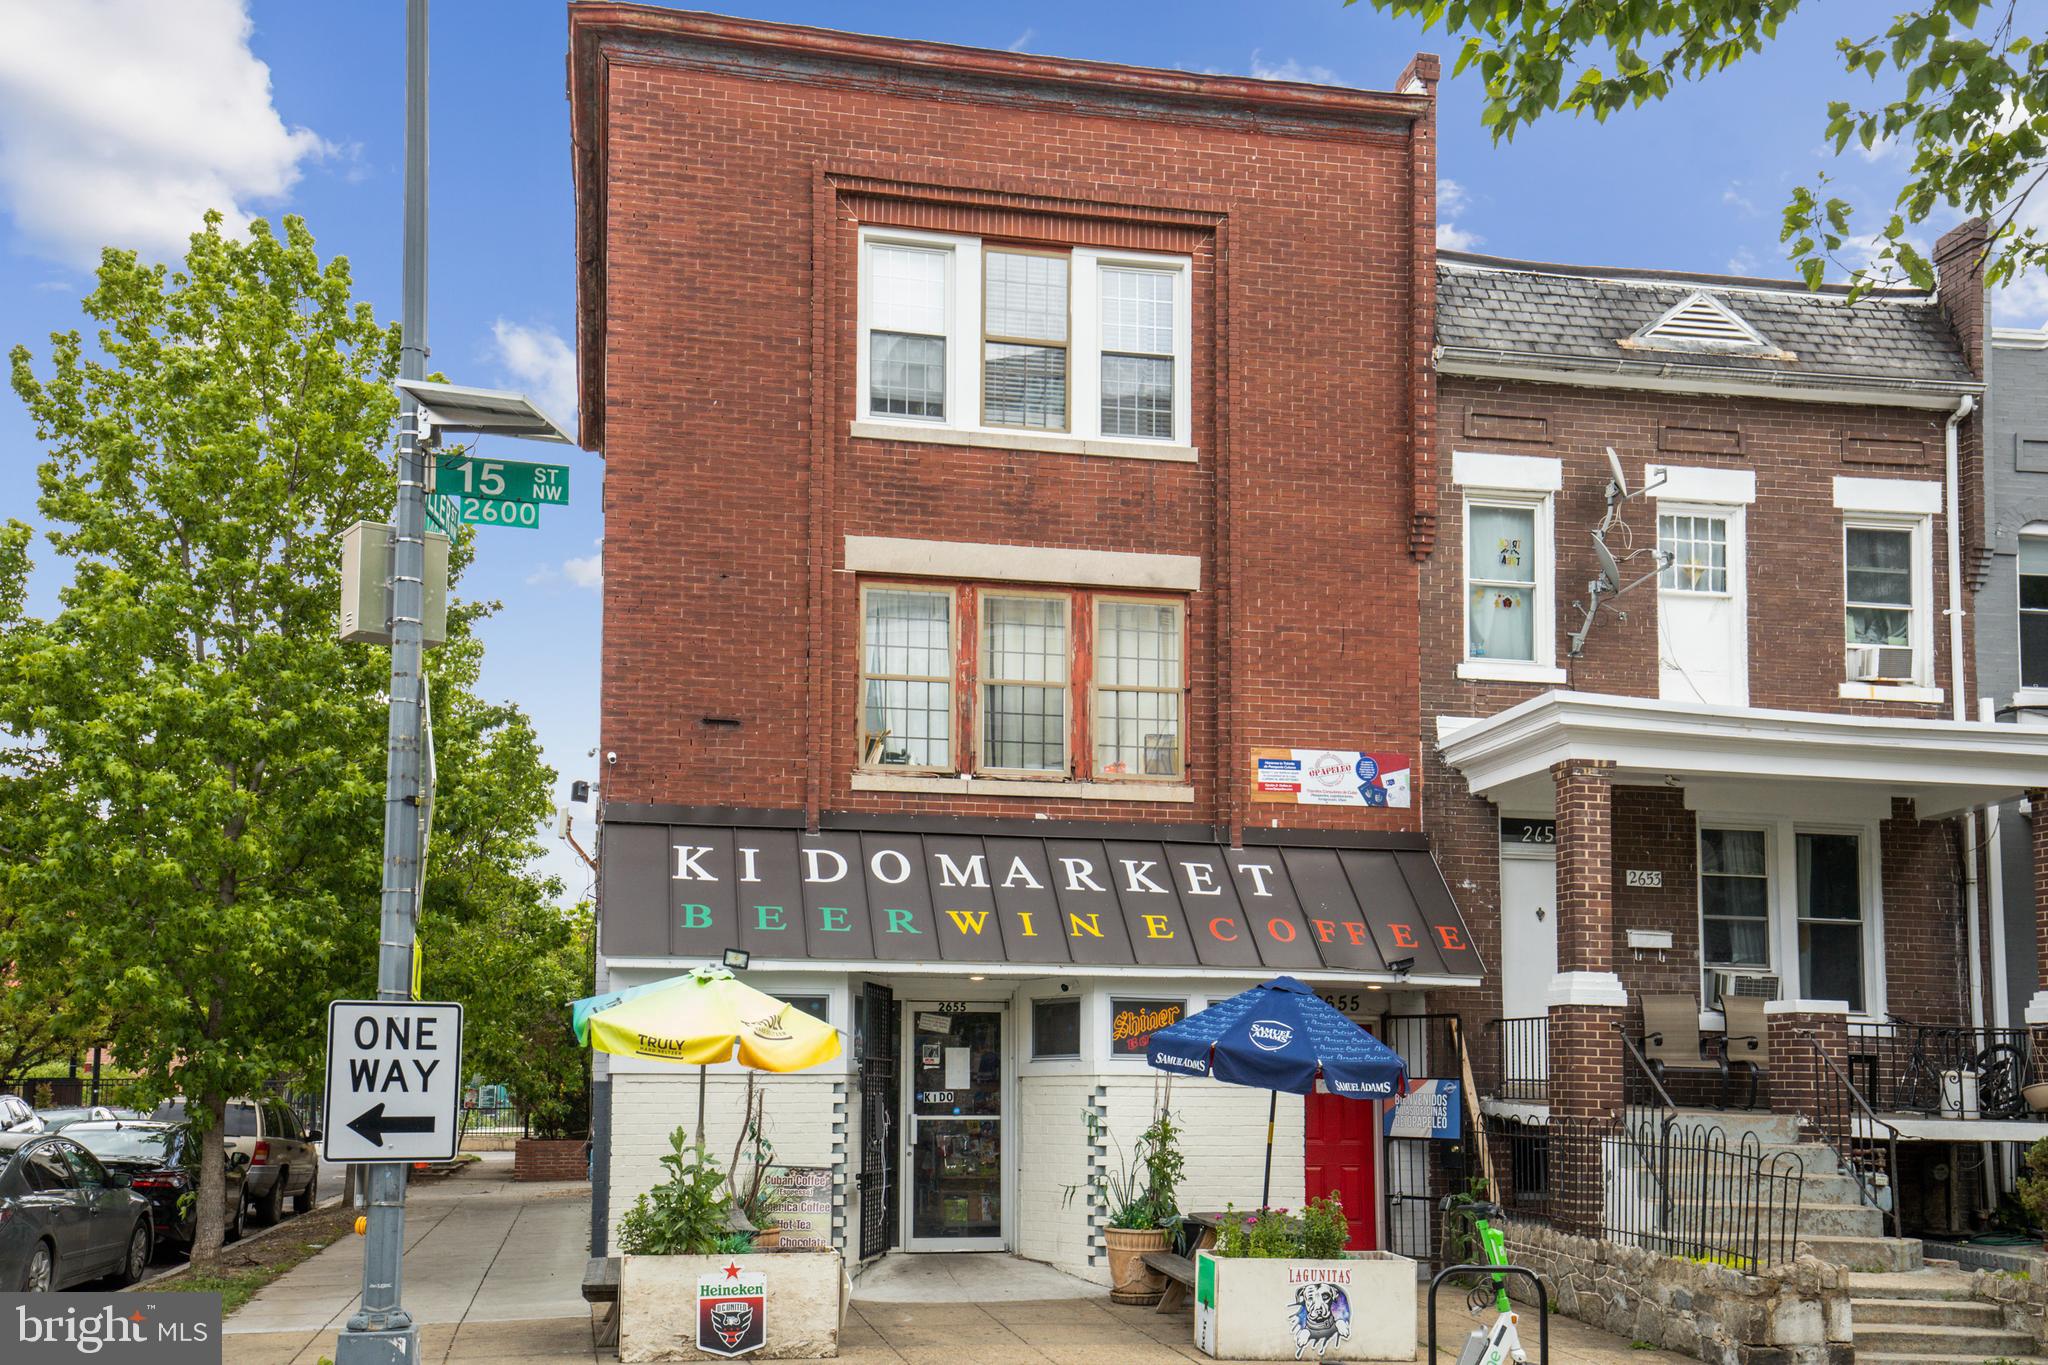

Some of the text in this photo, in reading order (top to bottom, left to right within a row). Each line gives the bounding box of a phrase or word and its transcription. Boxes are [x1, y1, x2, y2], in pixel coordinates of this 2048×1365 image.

[457, 461, 559, 496] 15 ST
[533, 484, 562, 500] NW
[463, 498, 536, 525] 2600
[1309, 764, 1352, 778] OPAPELEO
[1628, 871, 1661, 886] 2653
[680, 903, 1467, 950] BEER WINE COFFEE
[938, 1002, 967, 1012] 2655
[1322, 995, 1360, 1011] 655
[1113, 1006, 1180, 1041] Shiner
[354, 1016, 438, 1050] ONE
[1250, 1024, 1294, 1040] SAMUEL
[1251, 1030, 1288, 1043] ADAMS
[638, 1033, 685, 1051] TRULY
[349, 1059, 440, 1093] WAY
[1334, 1079, 1391, 1094] SAMUEL ADAMS
[924, 1092, 953, 1102] KIDO
[1394, 1093, 1447, 1106] BIENVENIDOS
[765, 1175, 826, 1186] Cuban Coffee
[762, 1202, 831, 1212] merica Coffee
[778, 1219, 811, 1229] Hot Tea
[780, 1237, 826, 1247] Chocolate
[1289, 1268, 1351, 1284] LAGUNITAS
[700, 1284, 764, 1297] Heineken
